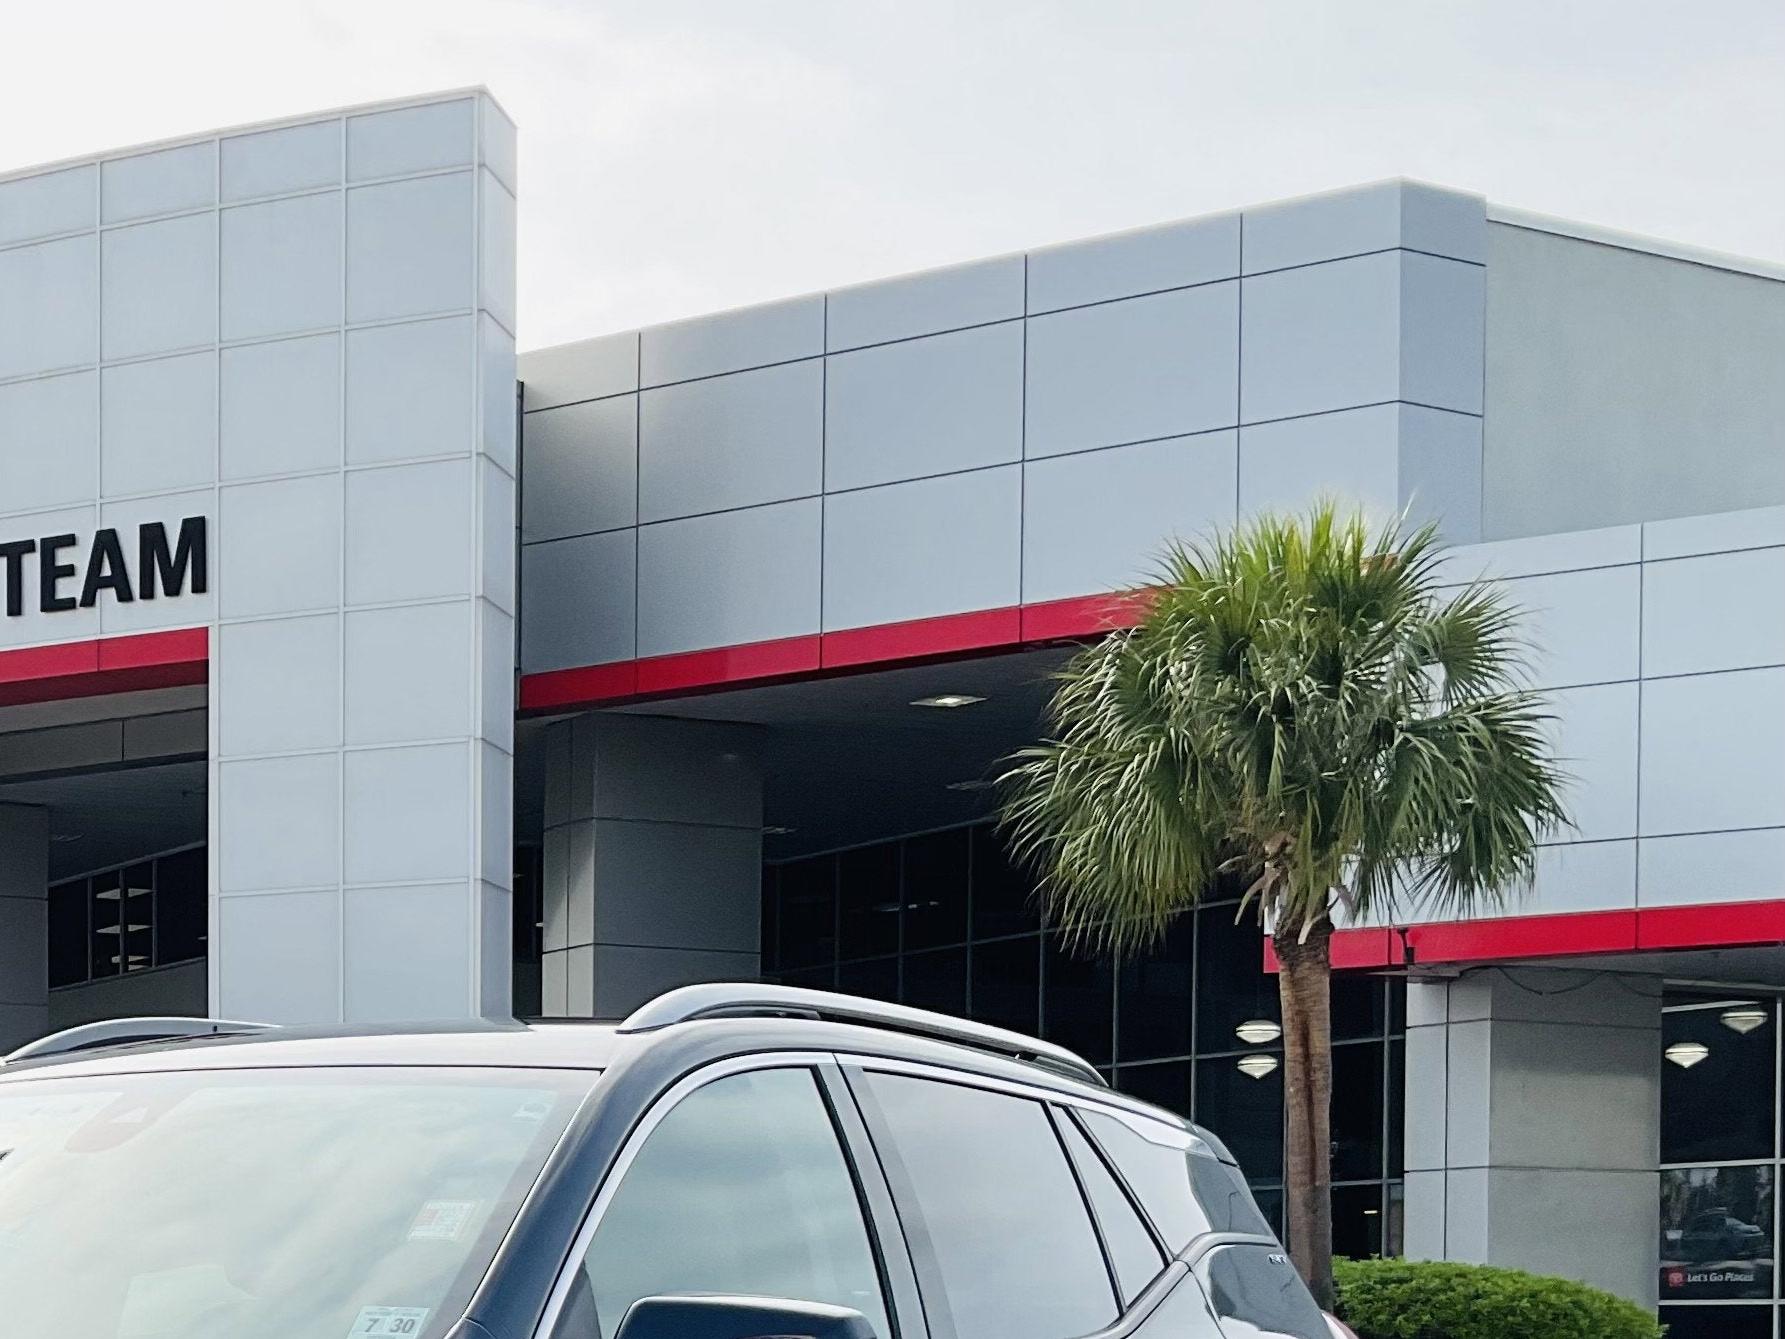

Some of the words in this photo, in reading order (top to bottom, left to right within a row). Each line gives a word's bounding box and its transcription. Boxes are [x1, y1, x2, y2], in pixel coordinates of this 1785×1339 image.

[1709, 1272, 1724, 1282] Go
[364, 1317, 381, 1333] 7
[389, 1317, 416, 1334] 30
